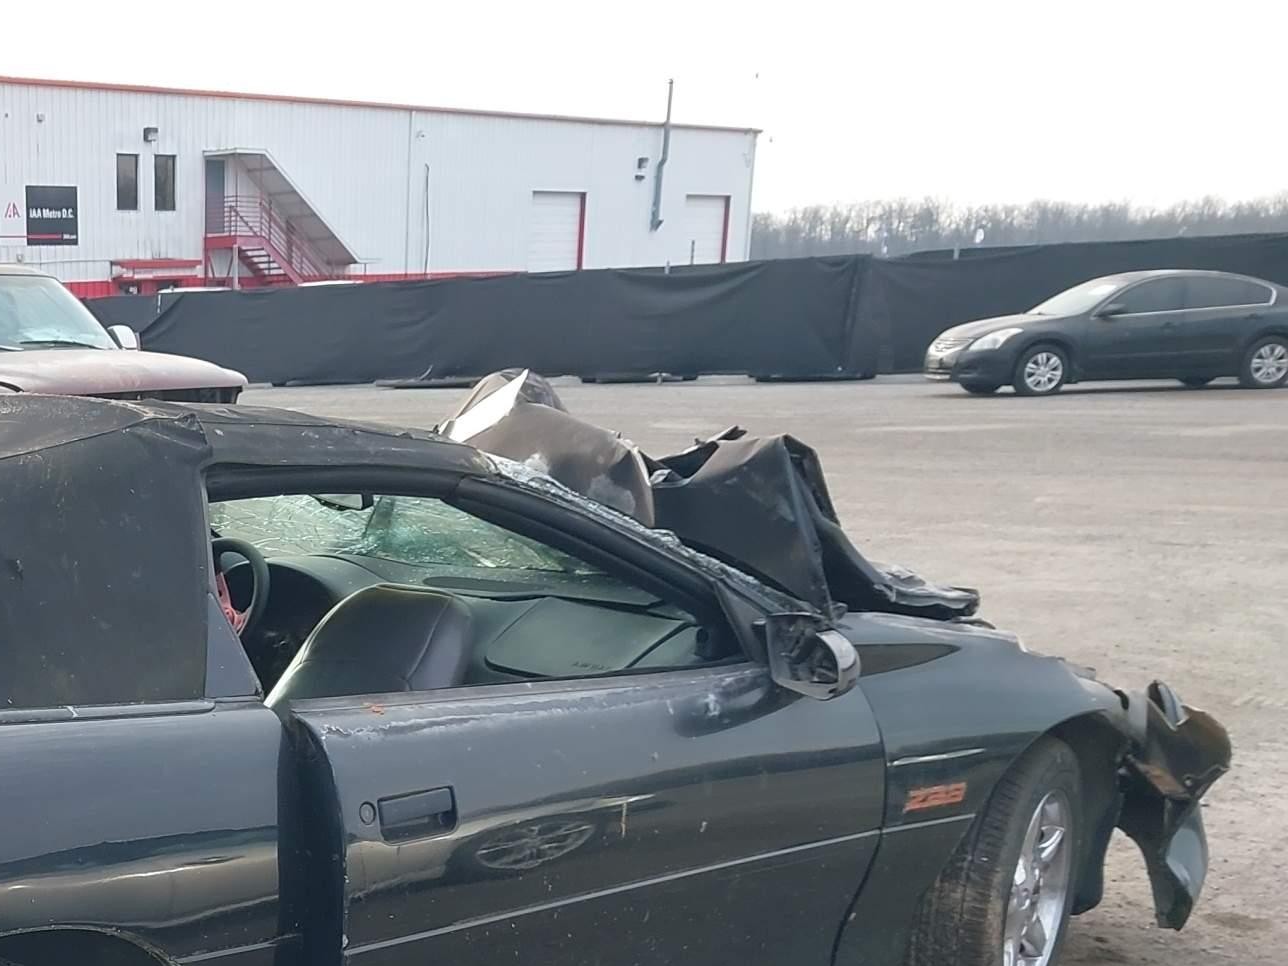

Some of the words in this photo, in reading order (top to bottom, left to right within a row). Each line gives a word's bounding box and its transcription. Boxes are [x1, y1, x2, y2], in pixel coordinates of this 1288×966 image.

[29, 208, 42, 218] IAA
[42, 208, 61, 219] Metro
[902, 782, 966, 814] Z28
